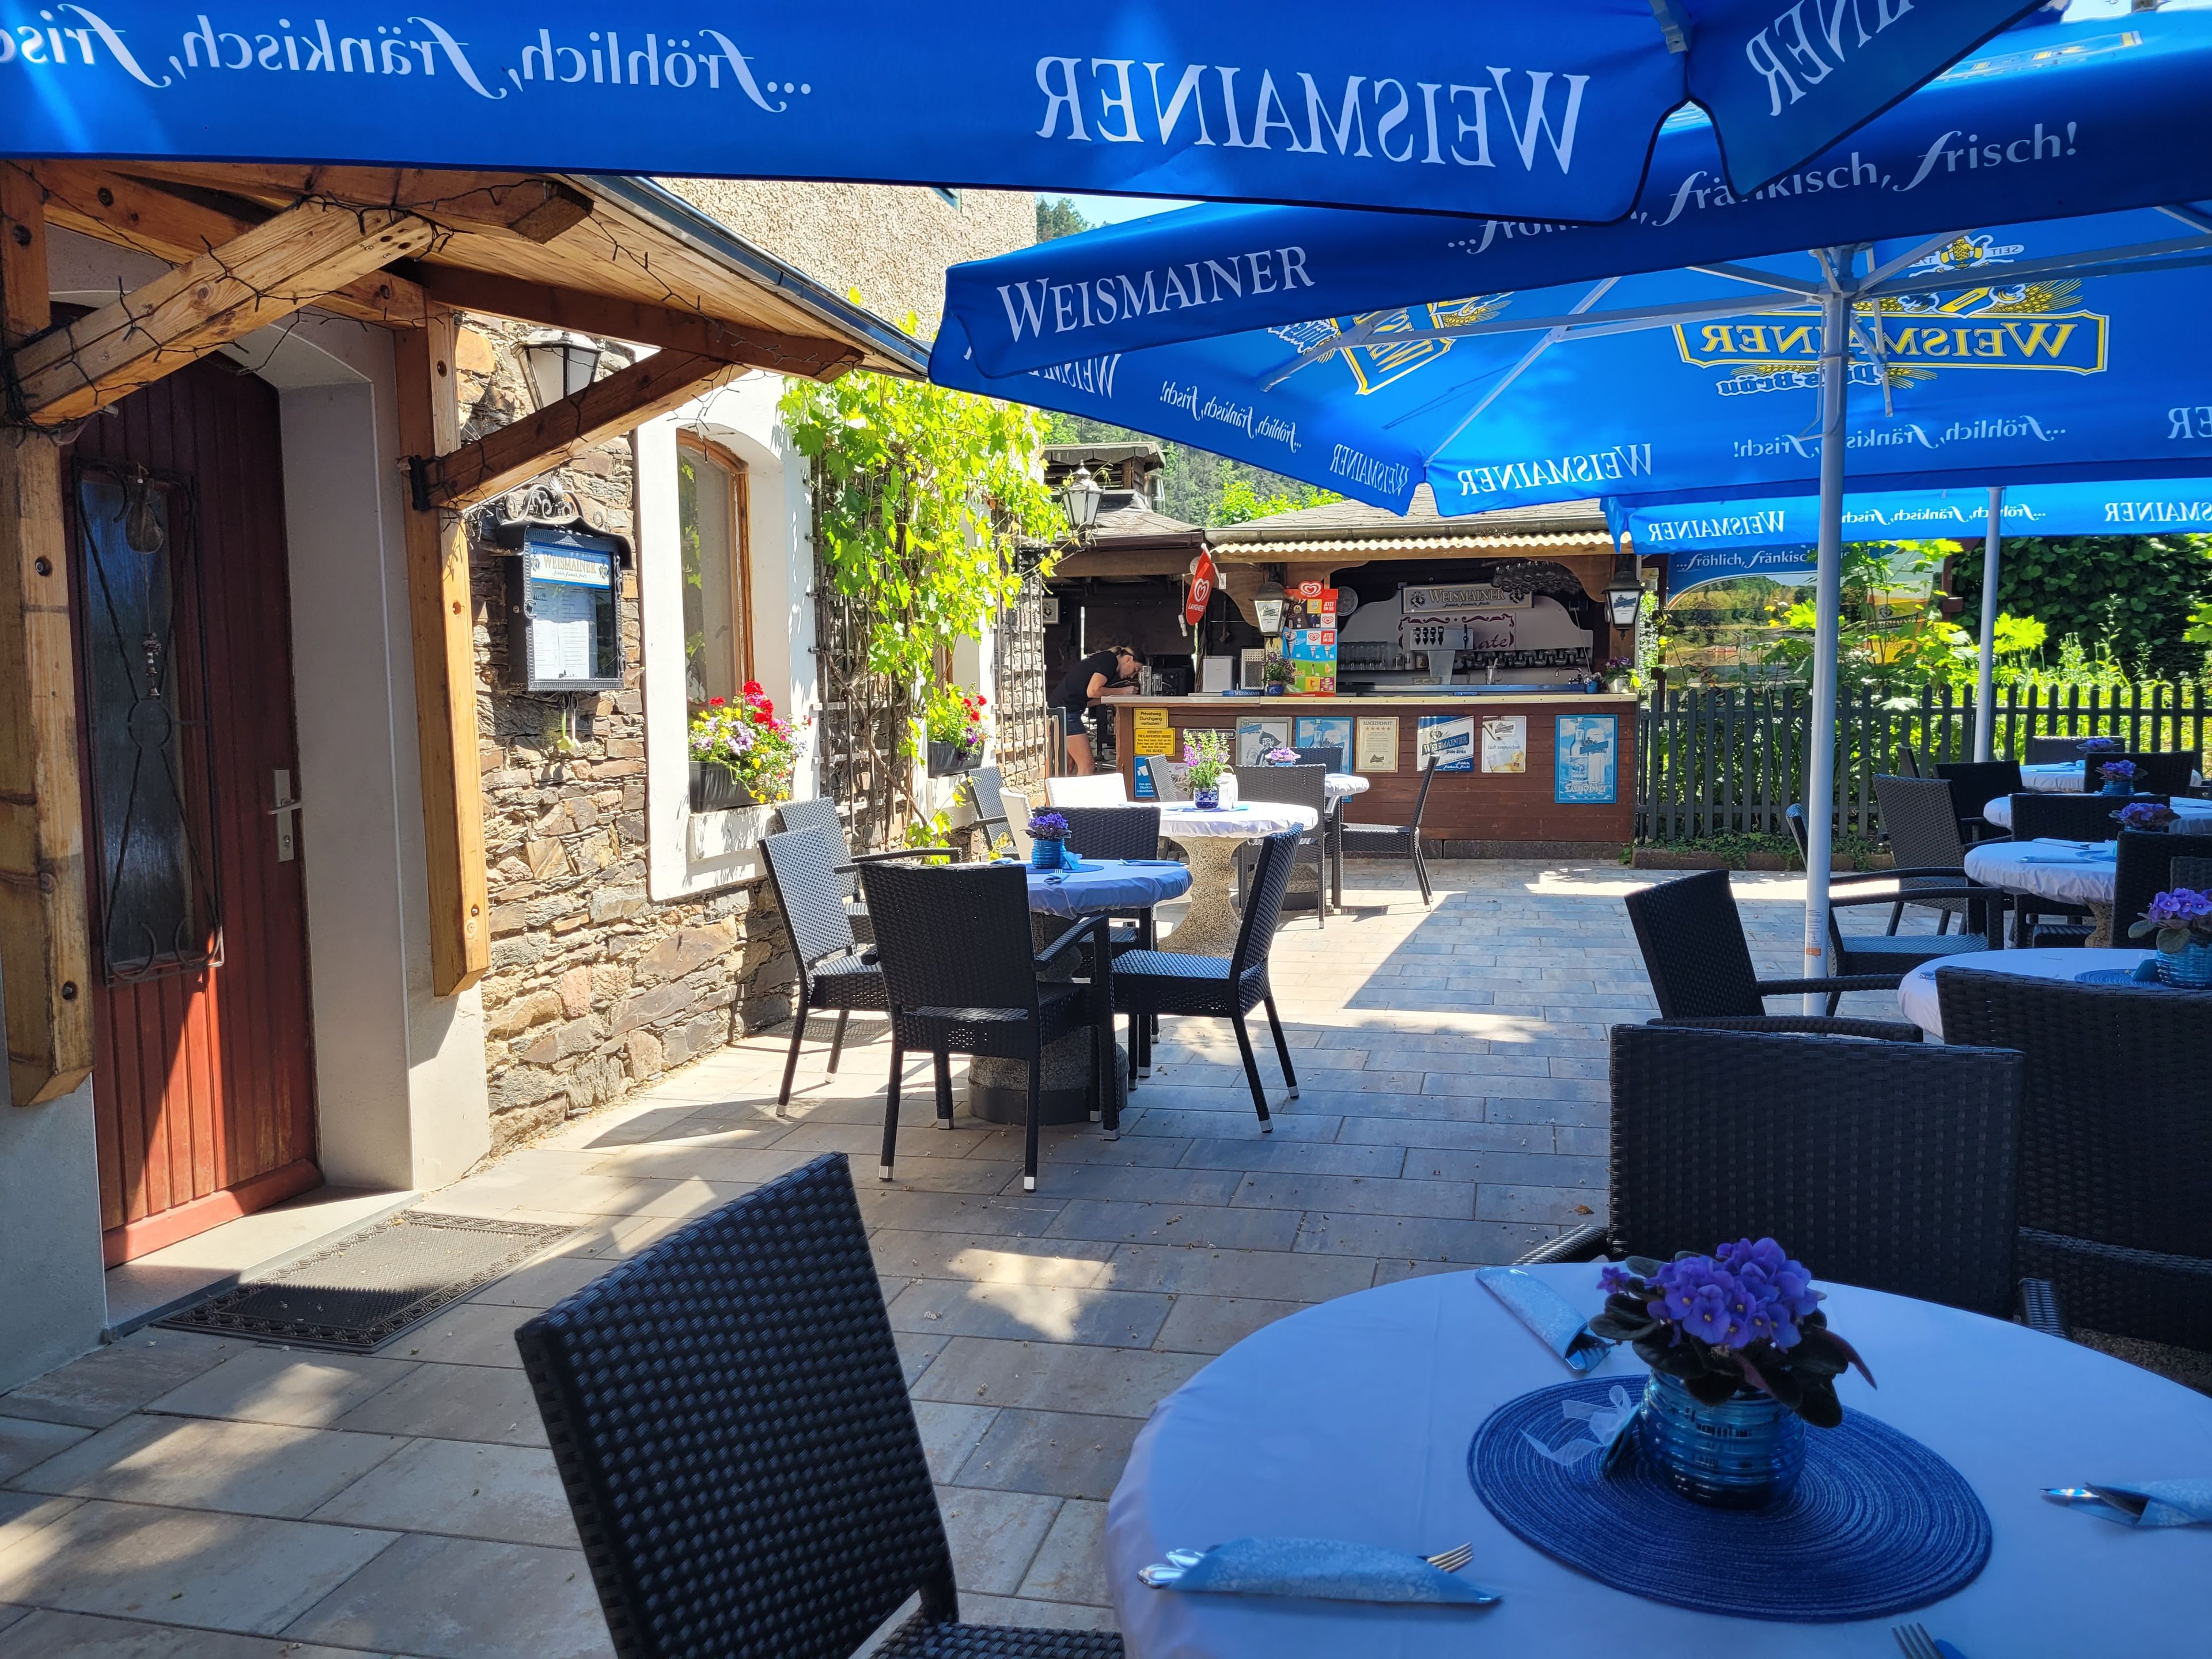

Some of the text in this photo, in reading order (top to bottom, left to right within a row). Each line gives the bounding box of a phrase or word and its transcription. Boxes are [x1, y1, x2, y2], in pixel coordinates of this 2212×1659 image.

[1652, 121, 2077, 226] fräkisch, frisch!
[997, 246, 1315, 343] WEISMAINER
[1744, 550, 1817, 569] fränkisc
[1429, 589, 1505, 603] WEISMAINER
